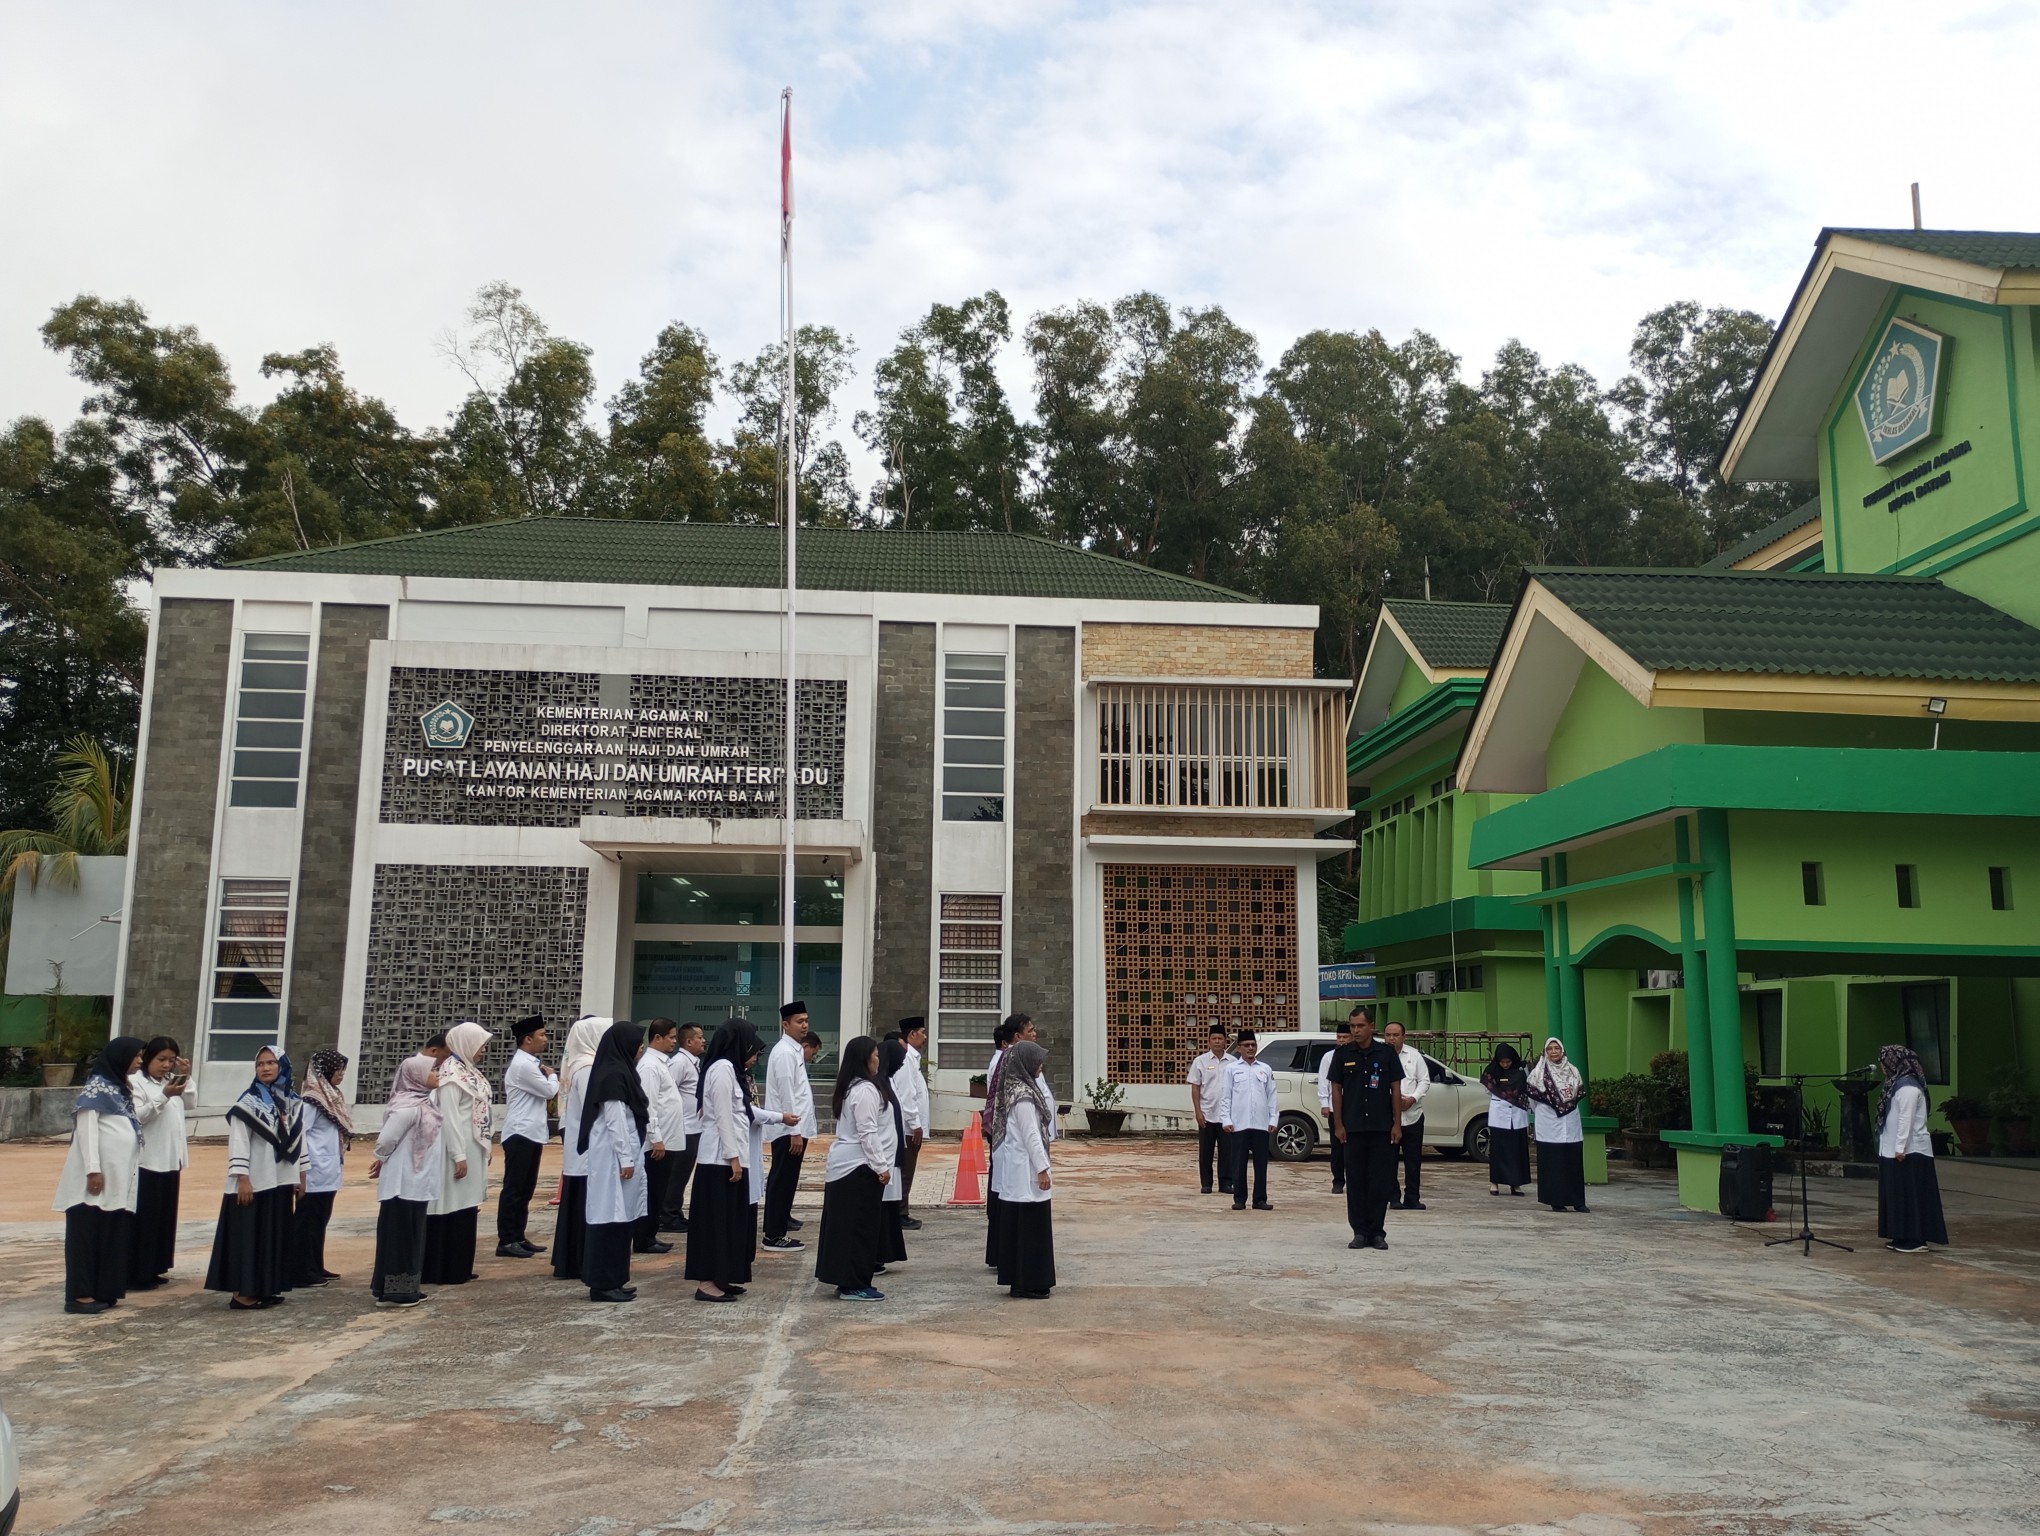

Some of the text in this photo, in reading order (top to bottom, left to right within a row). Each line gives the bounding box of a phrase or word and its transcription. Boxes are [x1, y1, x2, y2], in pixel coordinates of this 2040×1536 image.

[536, 706, 708, 723] KEMENTERIAN AGAMA RI
[541, 724, 627, 737] DIREKTORAT
[484, 740, 749, 758] PENYELENGGARAAN HAJI DAN UMRAH
[403, 758, 829, 785] PUSAT LAYANAN HAJI DAN UMRAH TERPDU
[466, 784, 775, 802] KANTOR KEMENTERIAN AGAMA KOTA BAAM
[1320, 971, 1337, 982] TOKO
